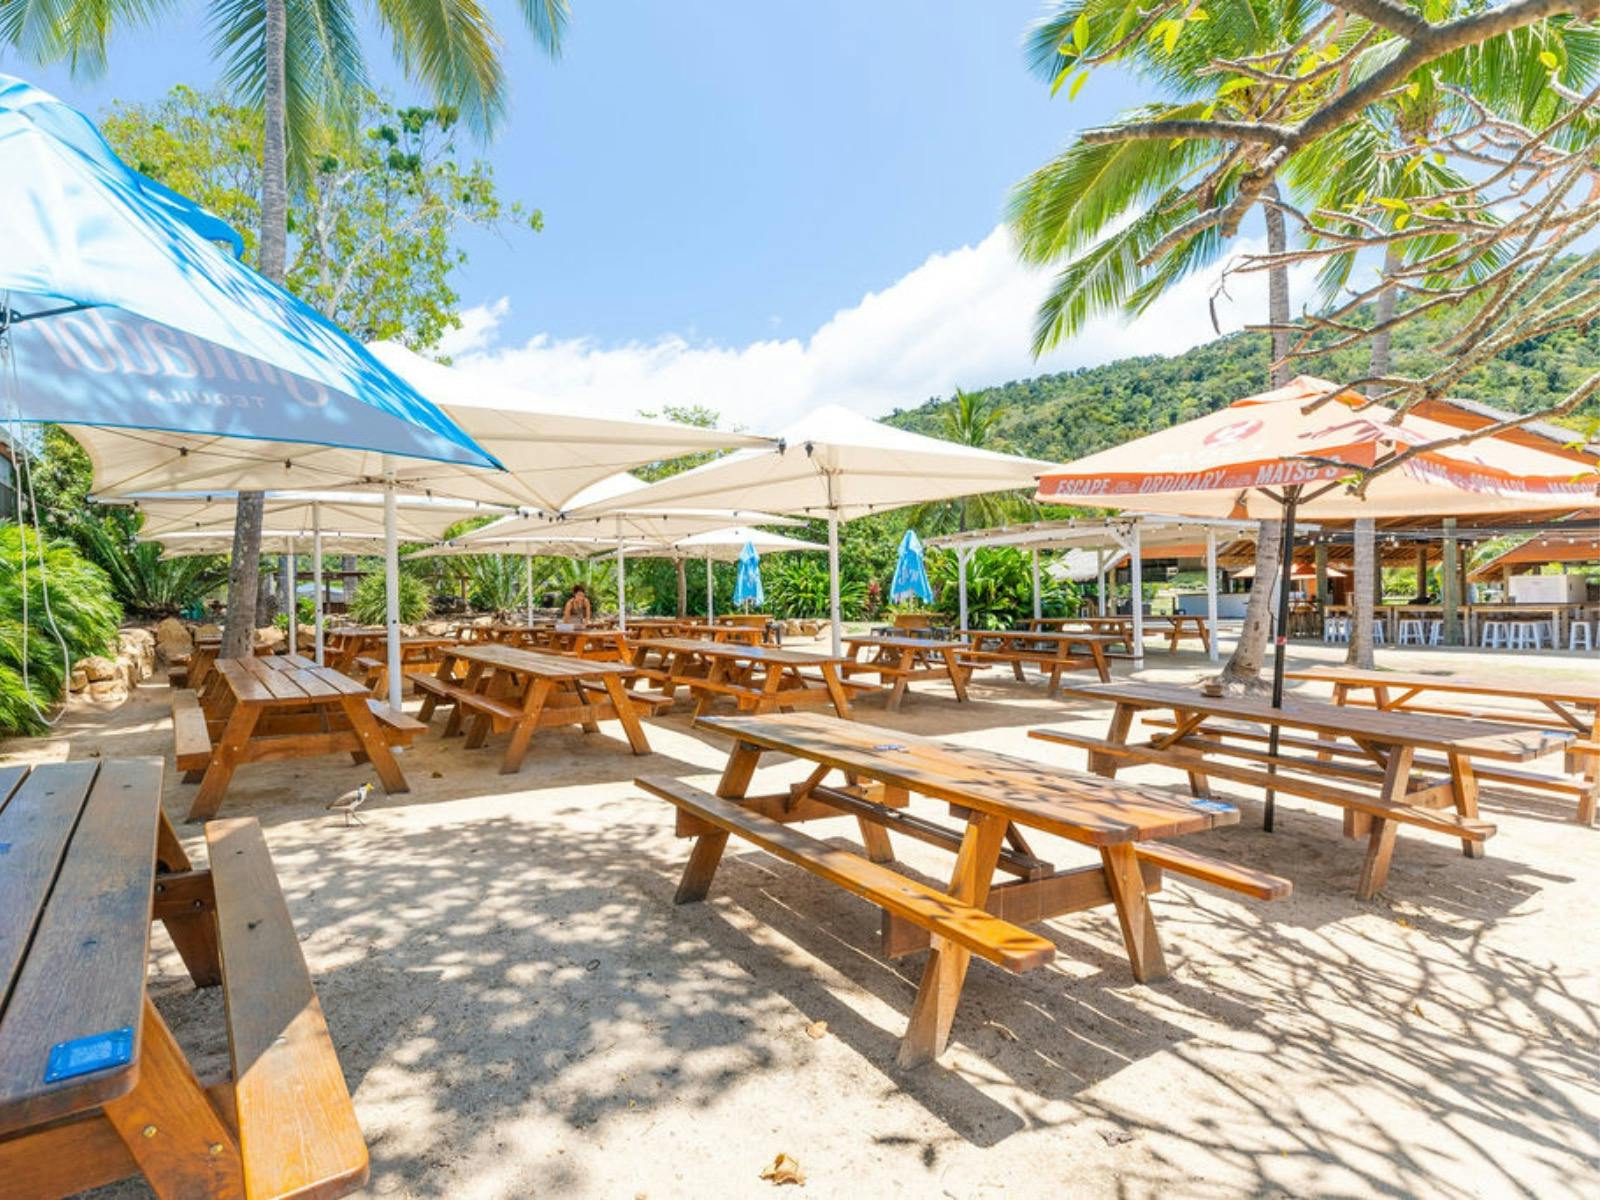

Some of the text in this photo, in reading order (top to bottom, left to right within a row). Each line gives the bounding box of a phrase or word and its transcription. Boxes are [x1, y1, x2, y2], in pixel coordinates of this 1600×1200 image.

[1055, 478, 1111, 496] ESCAPE
[1138, 470, 1226, 494] ORDINARY
[1255, 454, 1341, 485] MATSOS
